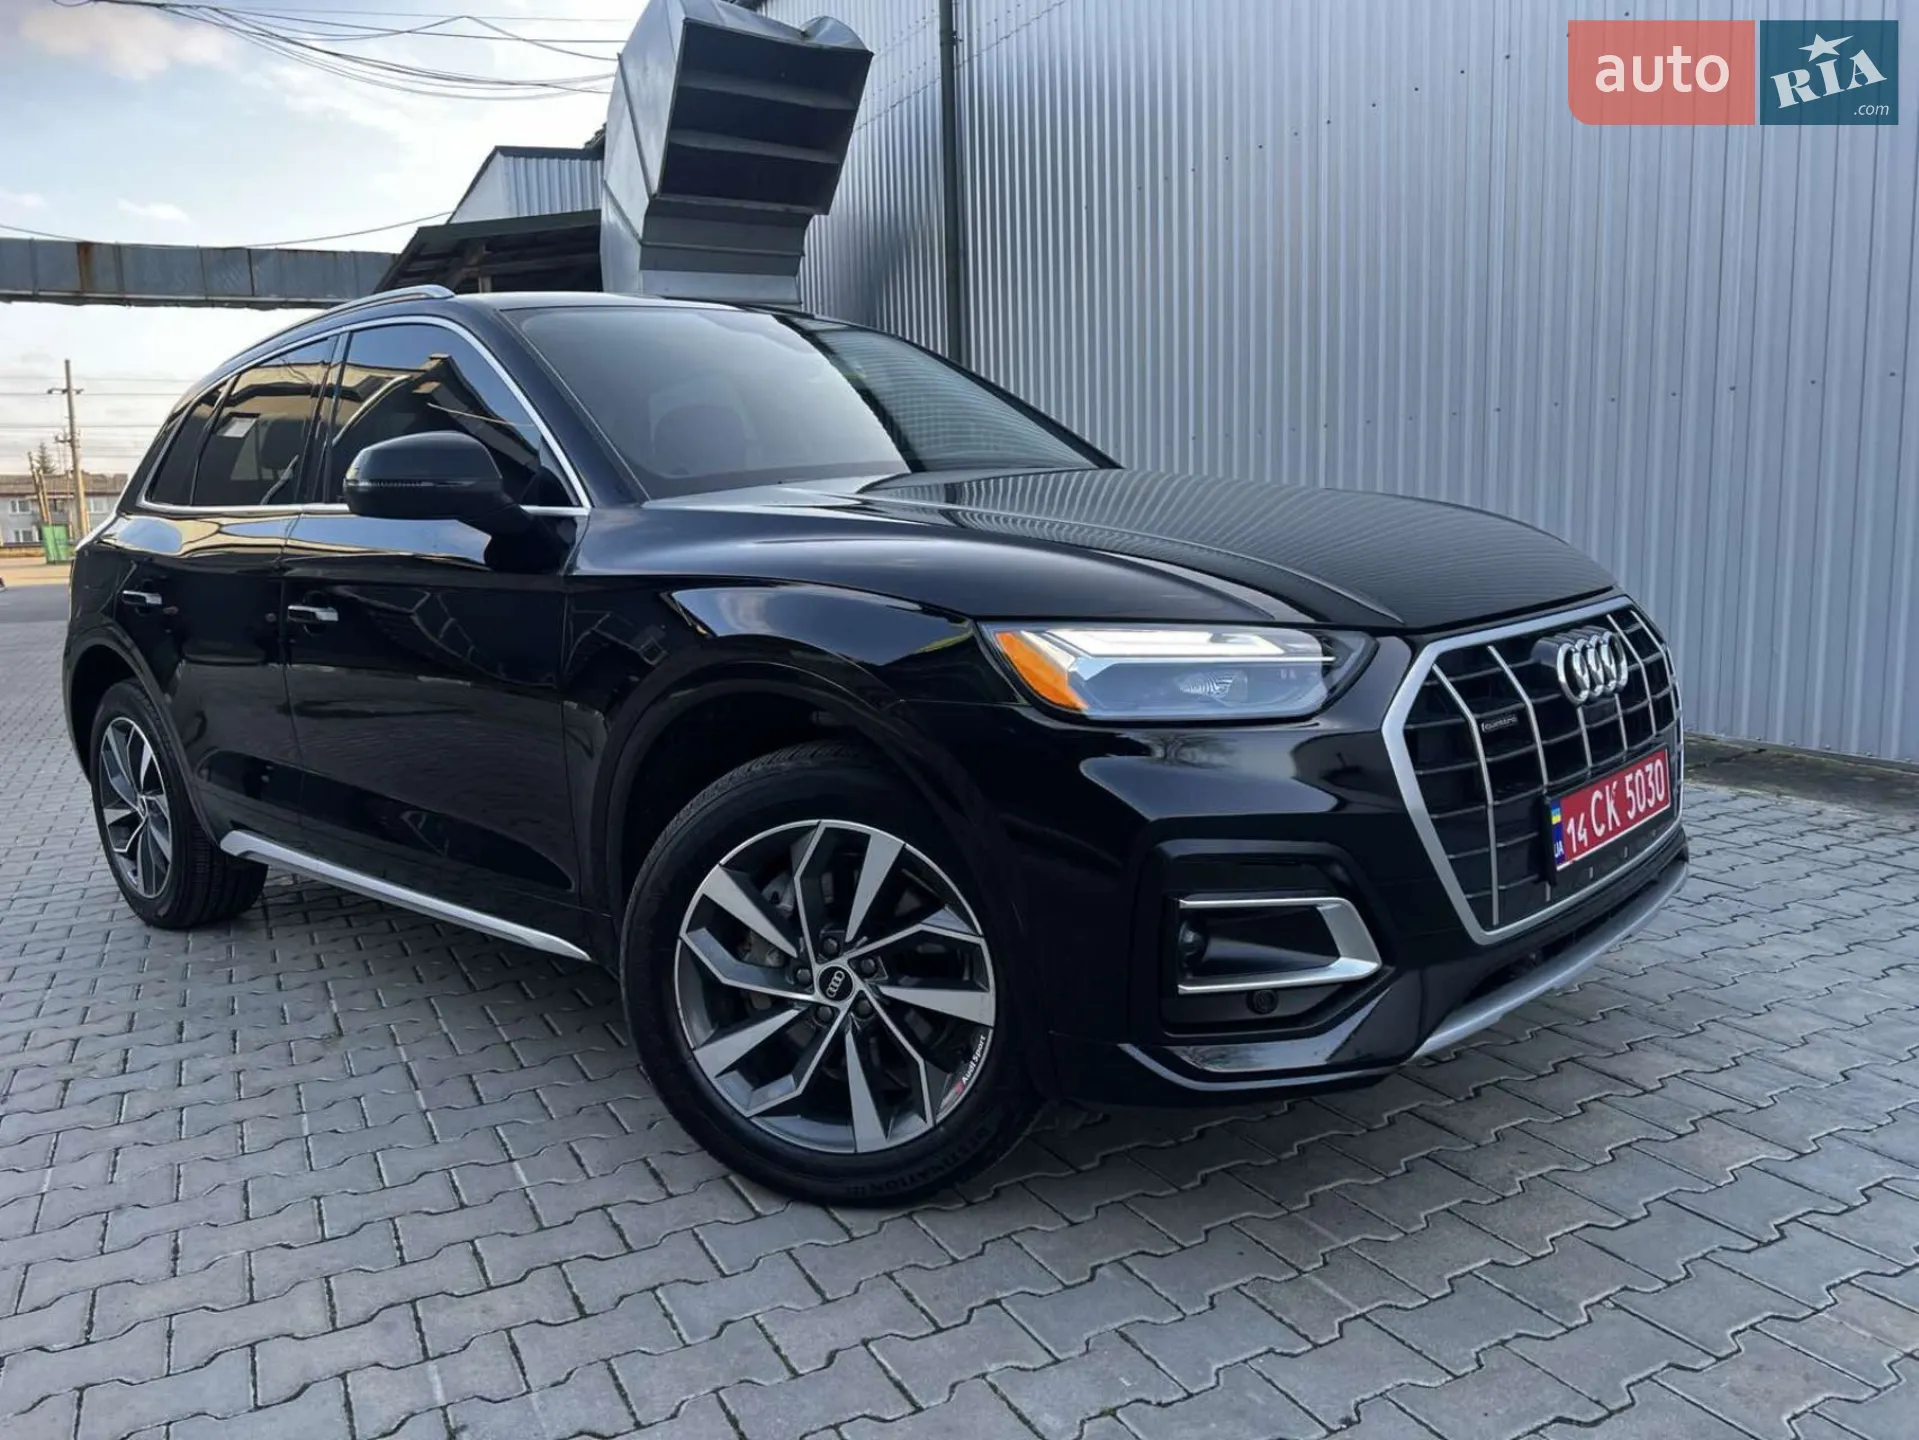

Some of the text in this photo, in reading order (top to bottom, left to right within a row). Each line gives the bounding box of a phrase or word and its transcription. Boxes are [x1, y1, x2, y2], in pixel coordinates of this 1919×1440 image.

[1567, 758, 1665, 853] 14 CK 5030
[1554, 840, 1565, 858] UA
[972, 1034, 986, 1062] Sport
